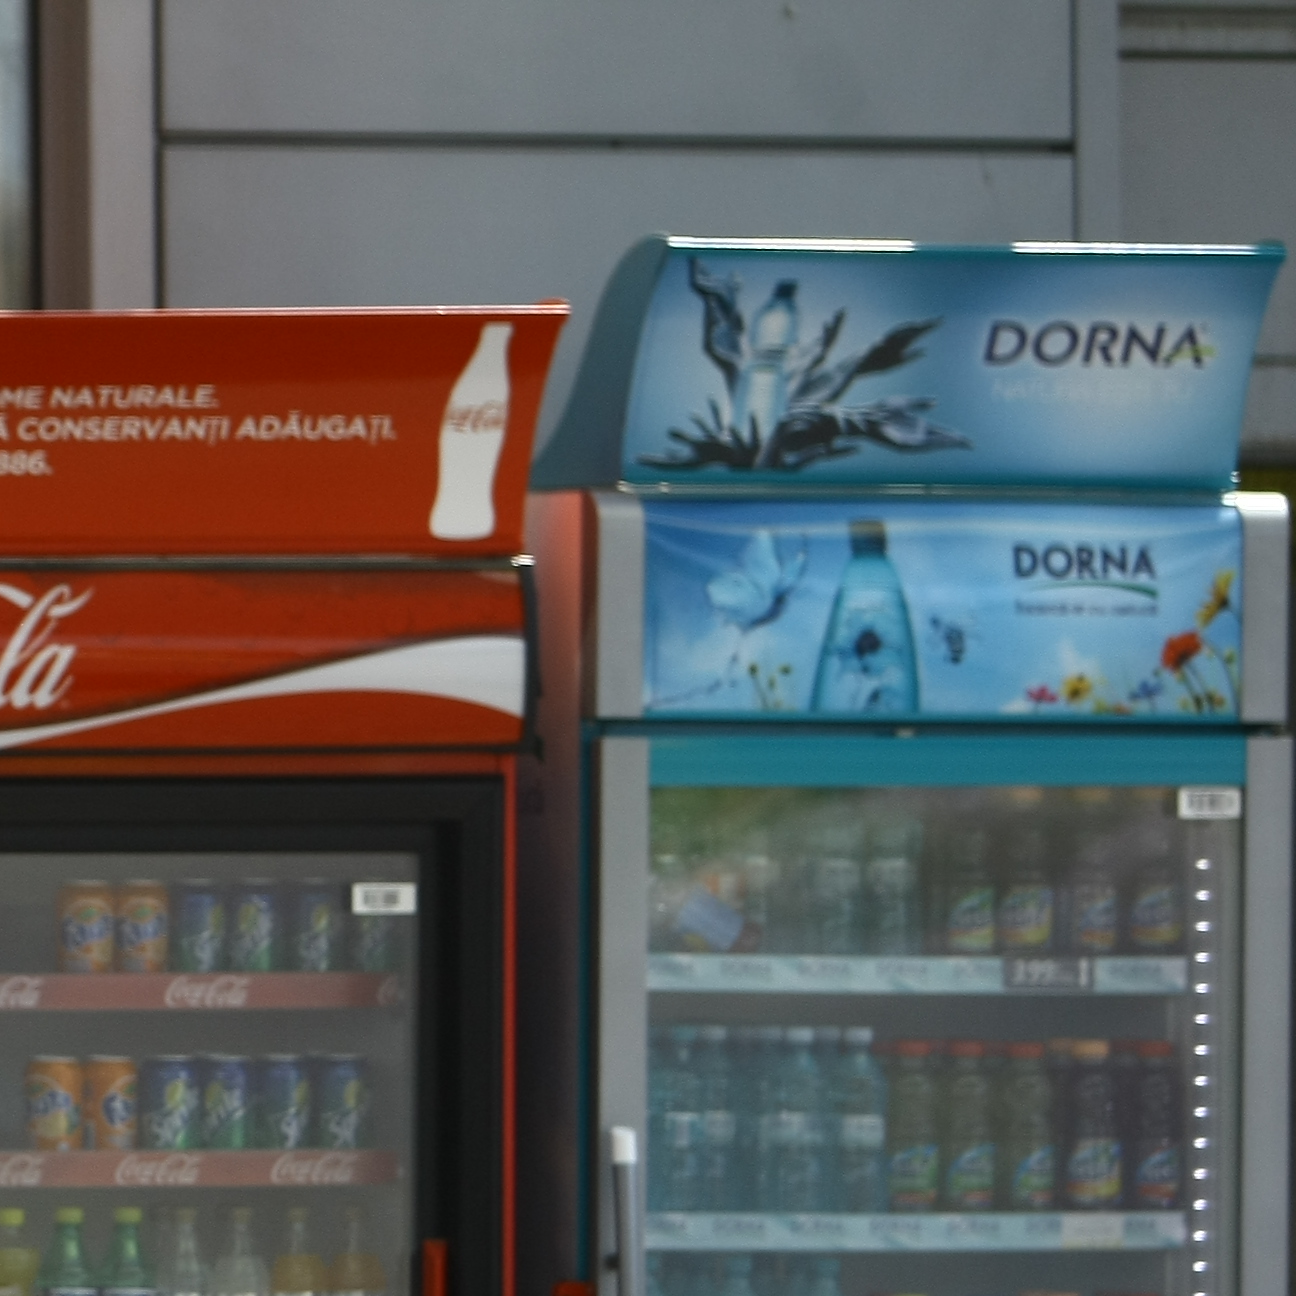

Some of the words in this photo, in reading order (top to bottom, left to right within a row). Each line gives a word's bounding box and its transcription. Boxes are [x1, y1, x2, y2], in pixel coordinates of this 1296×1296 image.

[983, 318, 1206, 368] DORNA
[49, 384, 218, 410] NATURALE.
[1012, 544, 1157, 579] DORNA
